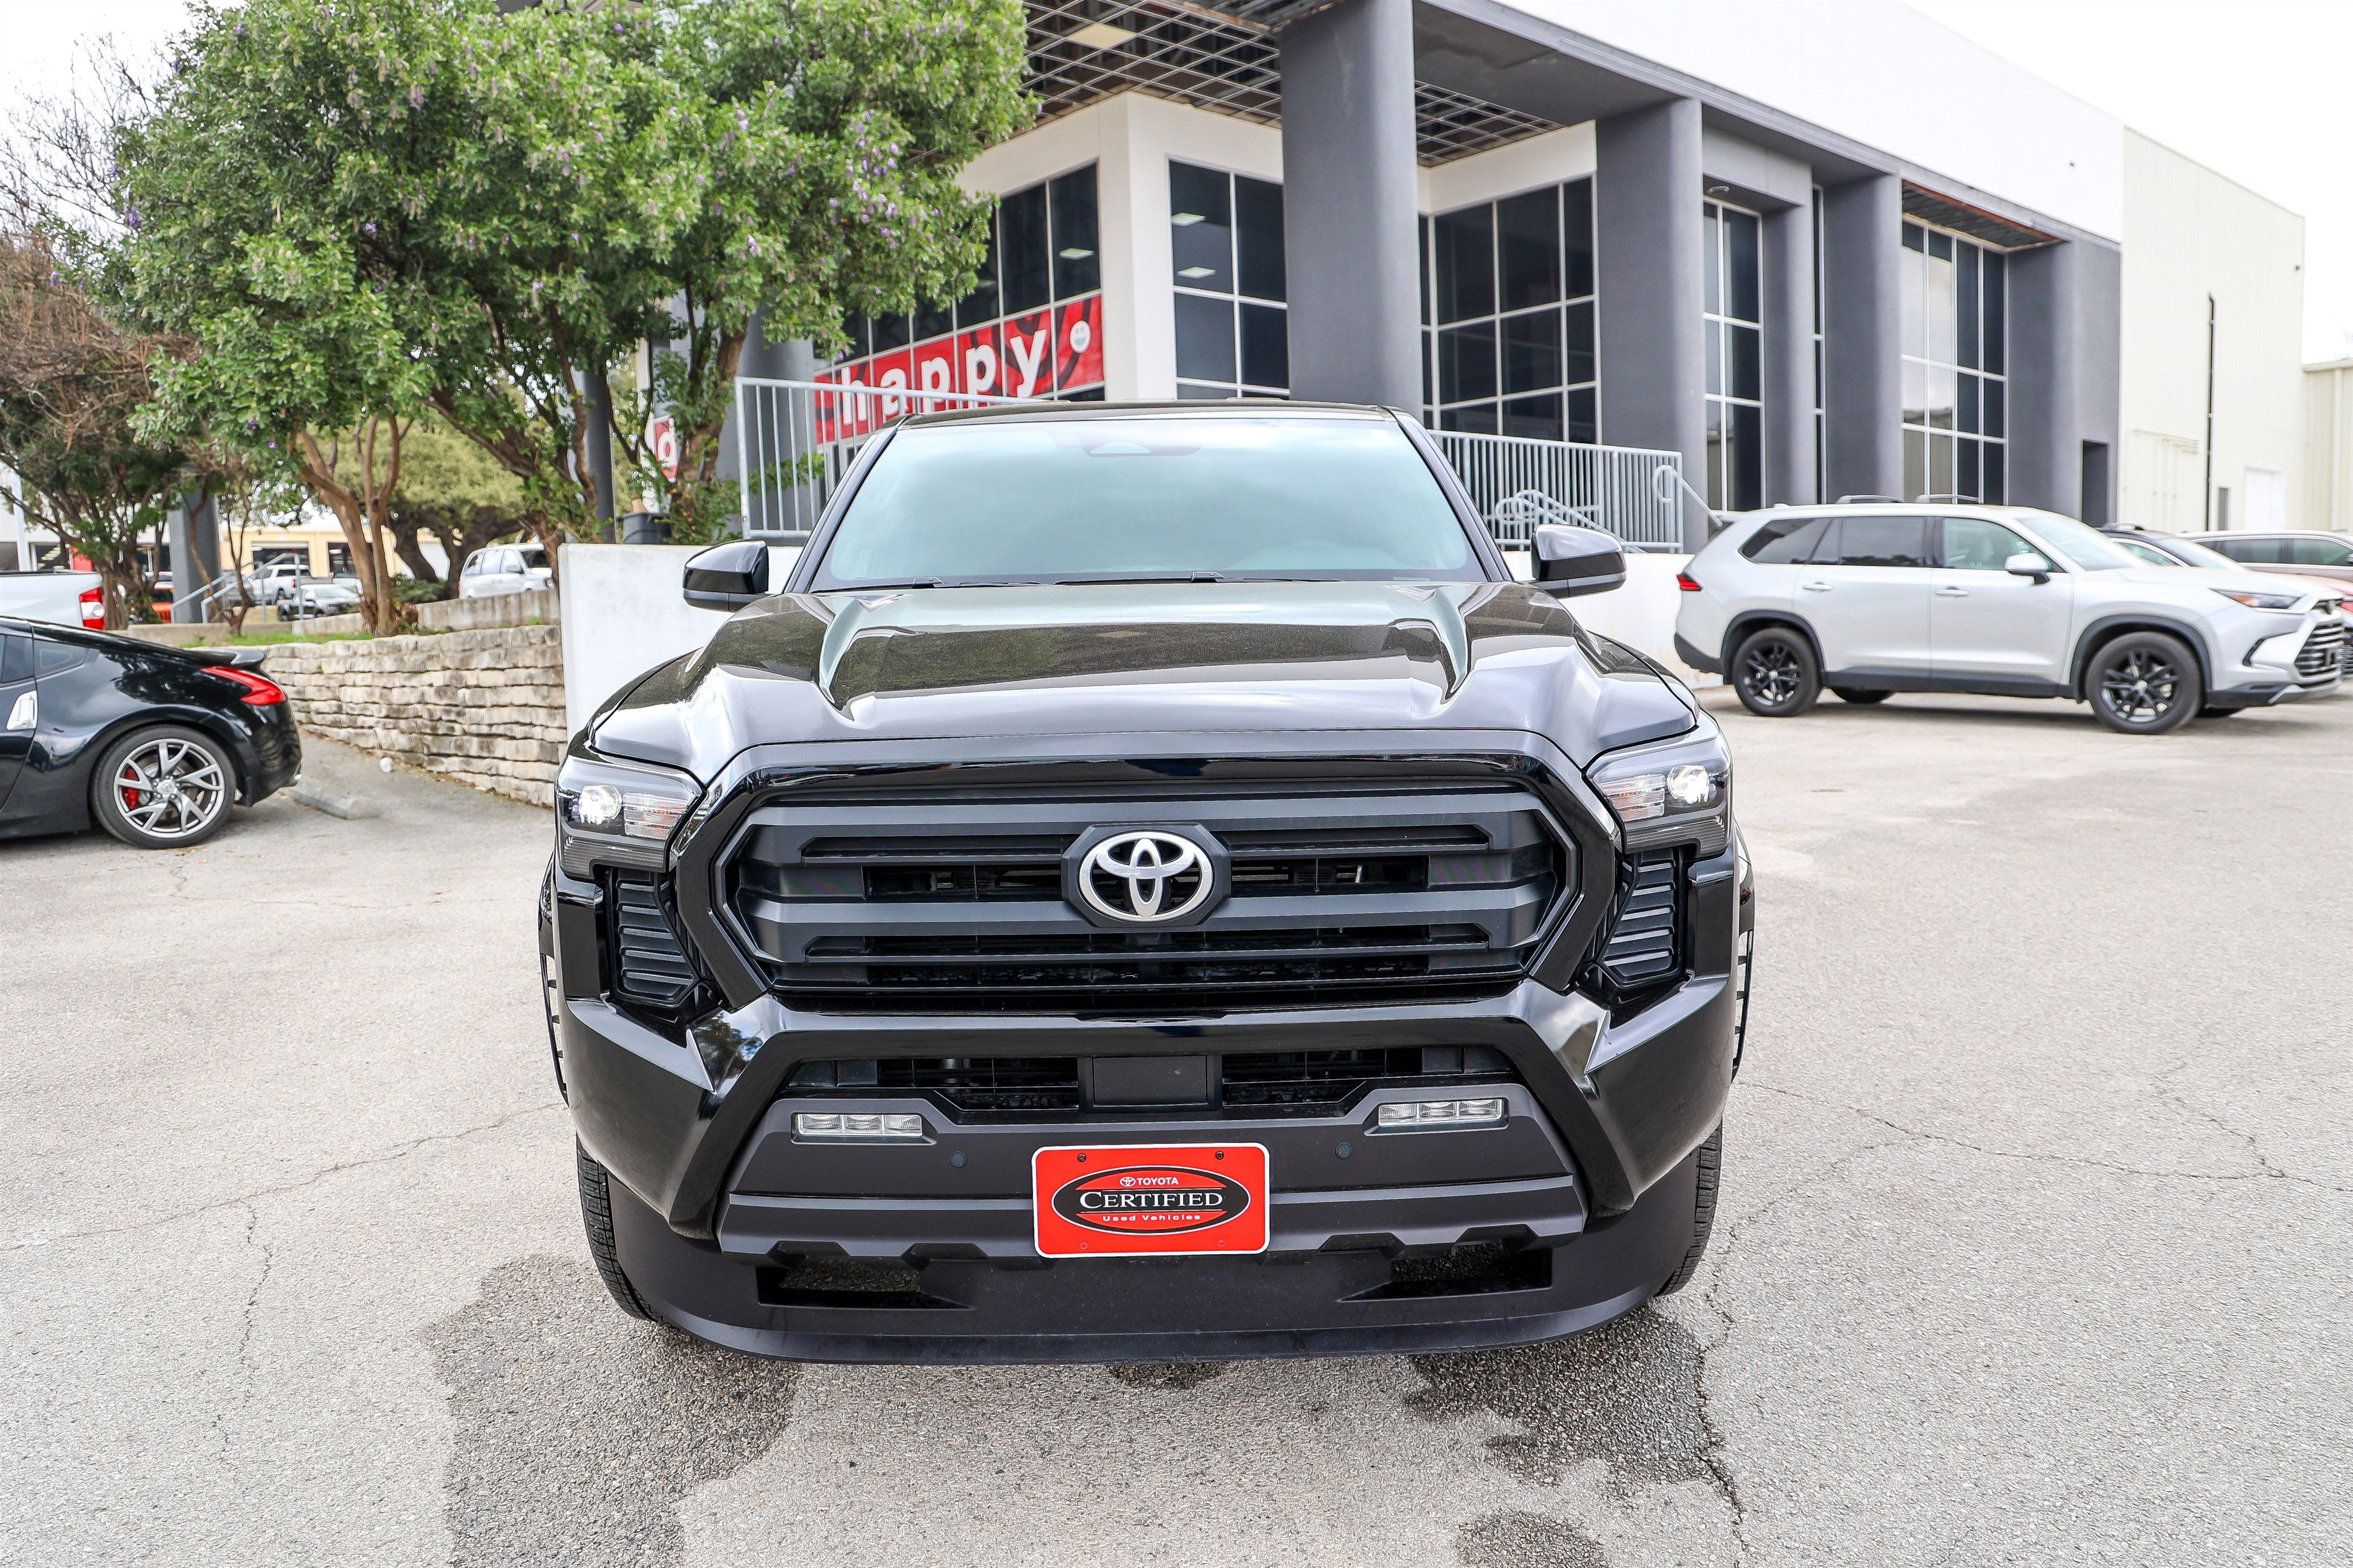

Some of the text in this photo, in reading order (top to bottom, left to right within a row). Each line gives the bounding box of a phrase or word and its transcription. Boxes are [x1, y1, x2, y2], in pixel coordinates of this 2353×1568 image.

[840, 329, 1046, 425] happy
[1137, 1177, 1179, 1185] TOYOTA
[1080, 1191, 1222, 1208] CERTIFIED
